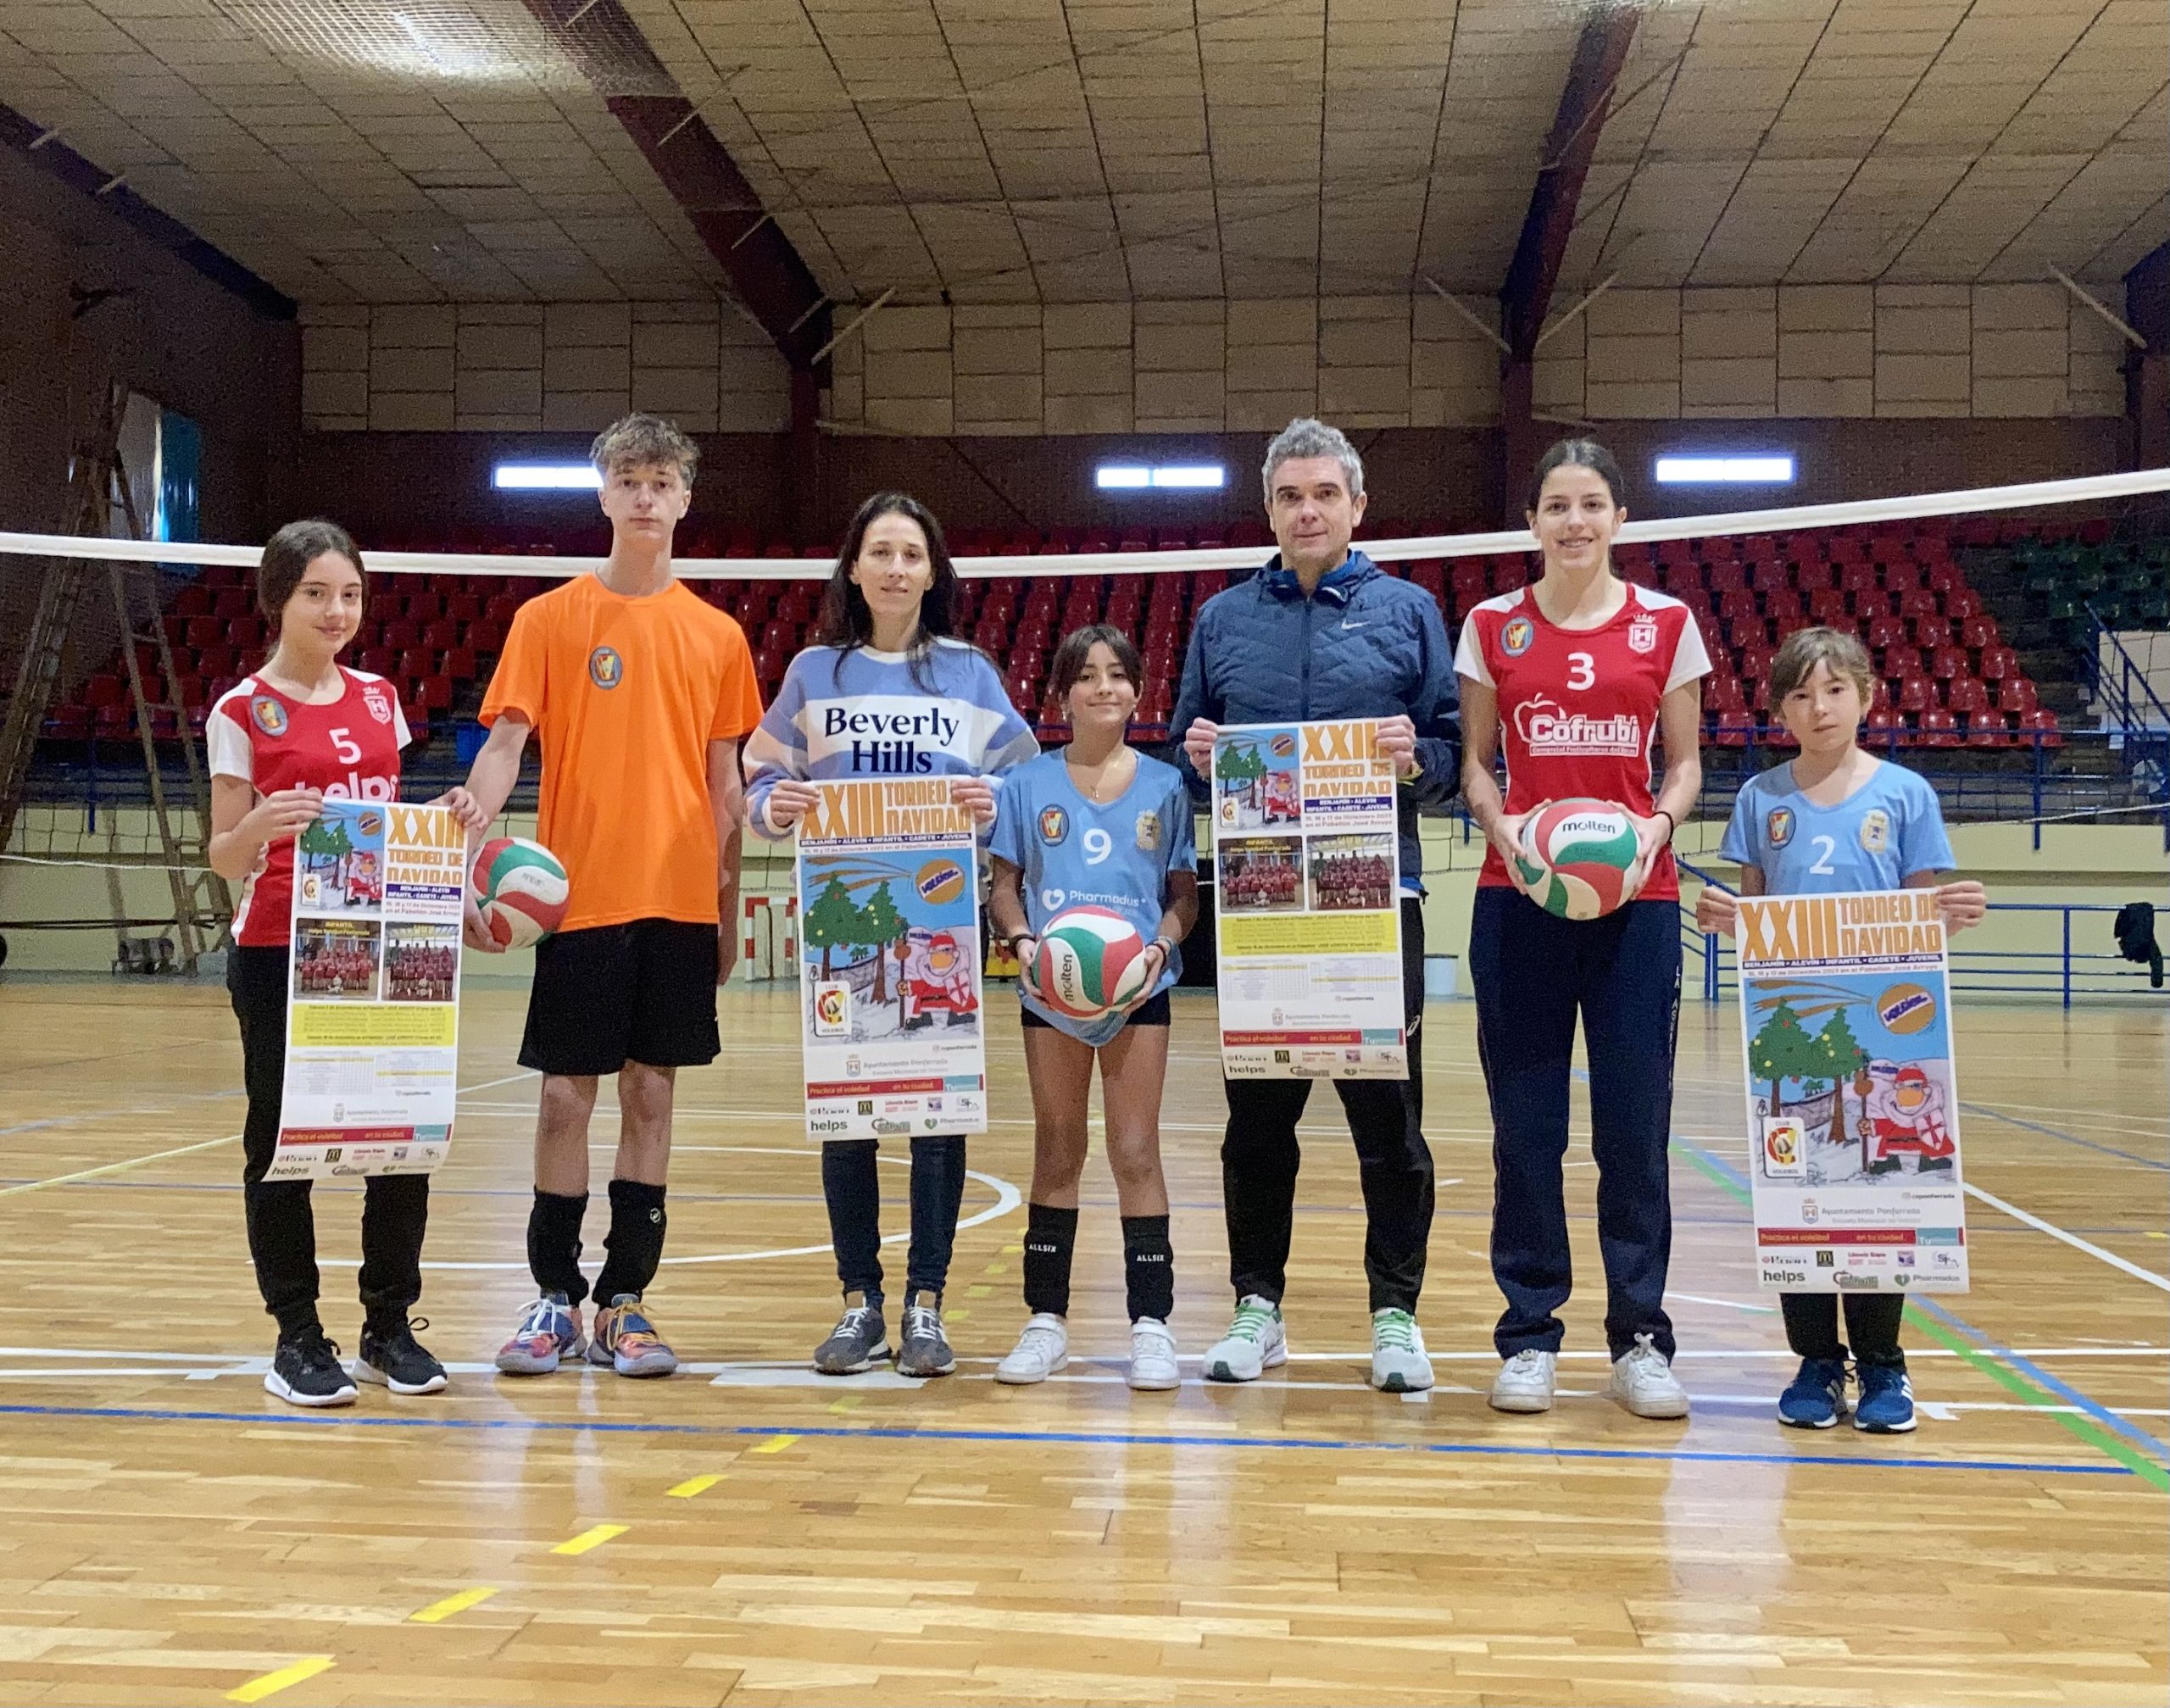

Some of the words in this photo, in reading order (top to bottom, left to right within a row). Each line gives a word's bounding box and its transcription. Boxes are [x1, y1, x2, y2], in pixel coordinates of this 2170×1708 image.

[1566, 652, 1594, 690] 3
[825, 707, 960, 746] Beverly
[1531, 715, 1638, 744] Cofrubi
[329, 728, 361, 764] 5
[852, 741, 932, 773] Hills
[1303, 764, 1365, 780] TORNEO
[1371, 763, 1391, 776] DE
[885, 780, 947, 807] TORNEO
[1304, 781, 1392, 798] NAVIDAD
[886, 807, 971, 834] NAVIDAD
[1562, 821, 1616, 834] molten
[388, 848, 442, 865] TORNEO
[448, 852, 463, 866] DE
[1083, 828, 1112, 865] 9
[1809, 835, 1835, 875] 2
[387, 867, 463, 885] NAVIDAD
[1069, 890, 1139, 907] Pharmadus
[1838, 895, 1912, 925] TORNEO
[1739, 899, 1839, 960] XXIII
[1841, 924, 1942, 955] NAVIDAD
[1061, 954, 1075, 1001] molten
[1229, 1065, 1266, 1075] helps
[811, 1119, 848, 1132] helps
[271, 1166, 309, 1175] helps
[1763, 1270, 1806, 1283] helps
